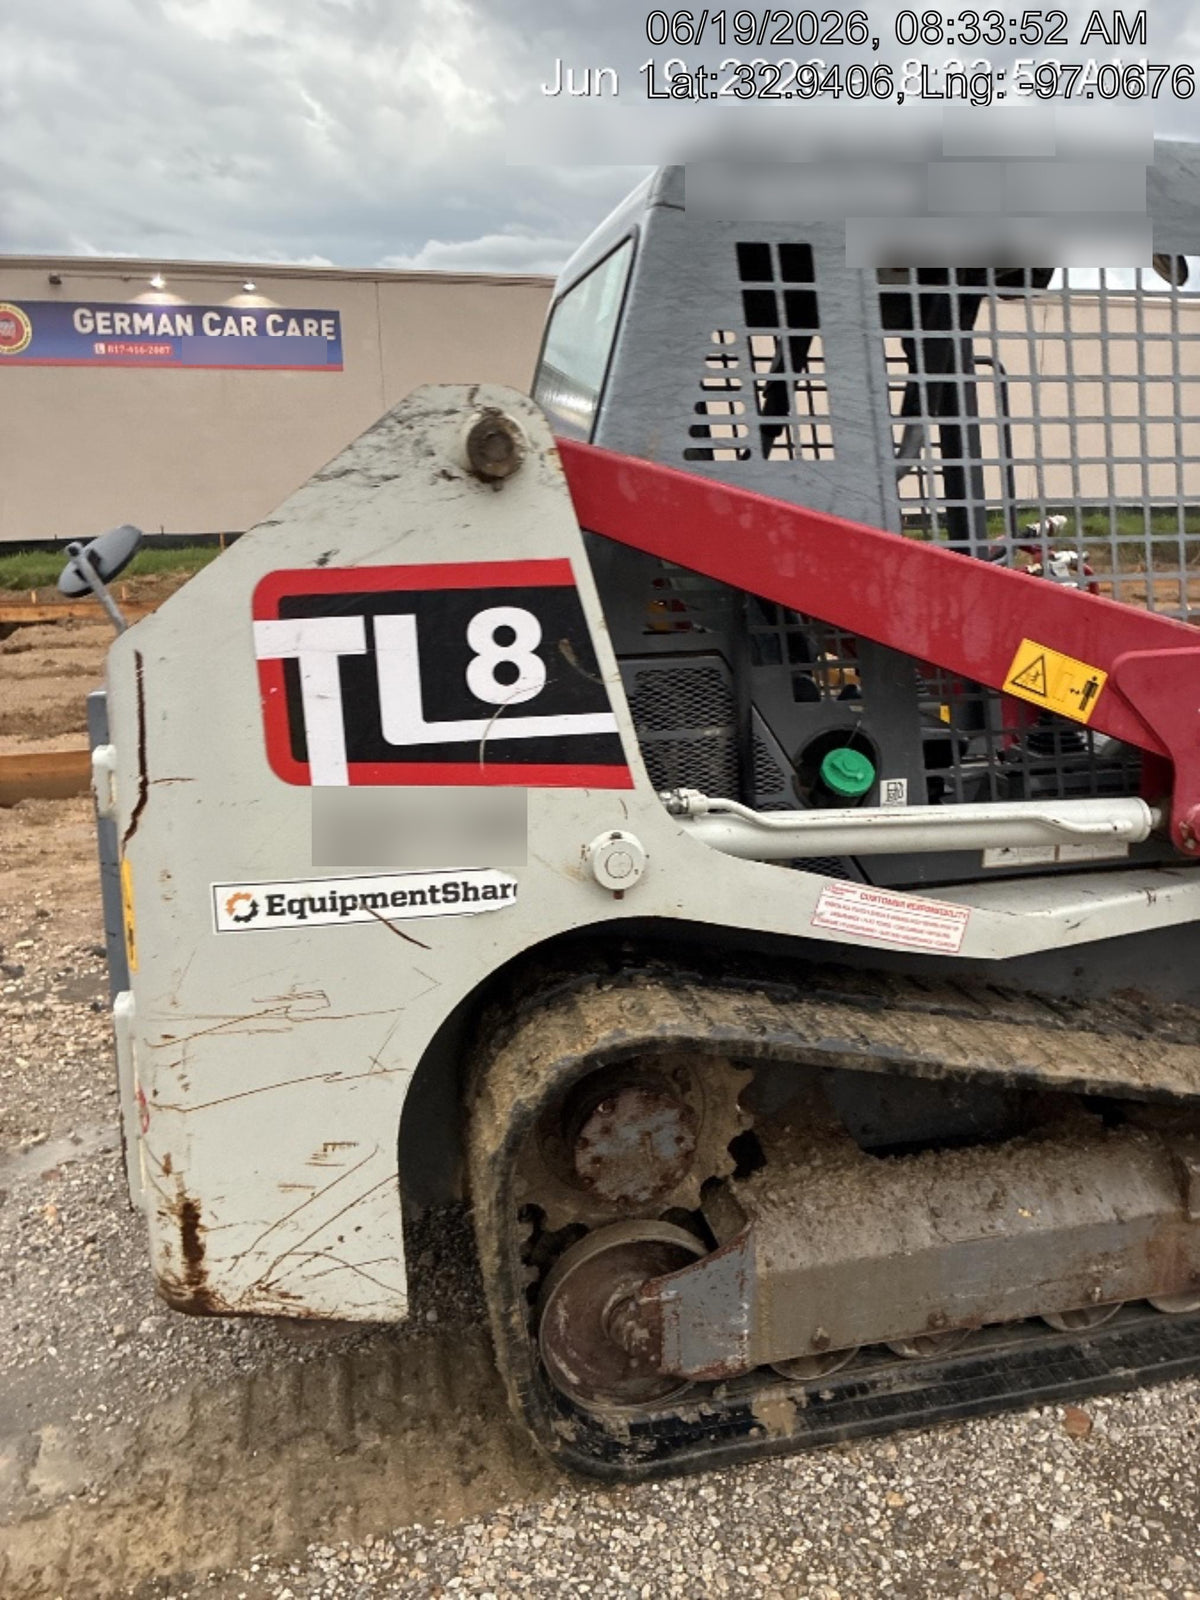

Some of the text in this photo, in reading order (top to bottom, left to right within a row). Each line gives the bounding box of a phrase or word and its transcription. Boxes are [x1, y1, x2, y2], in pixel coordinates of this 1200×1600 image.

[73, 307, 336, 341] GERMAN CAR CARE
[252, 605, 619, 787] TL8
[264, 881, 518, 919] EquipmentShar
